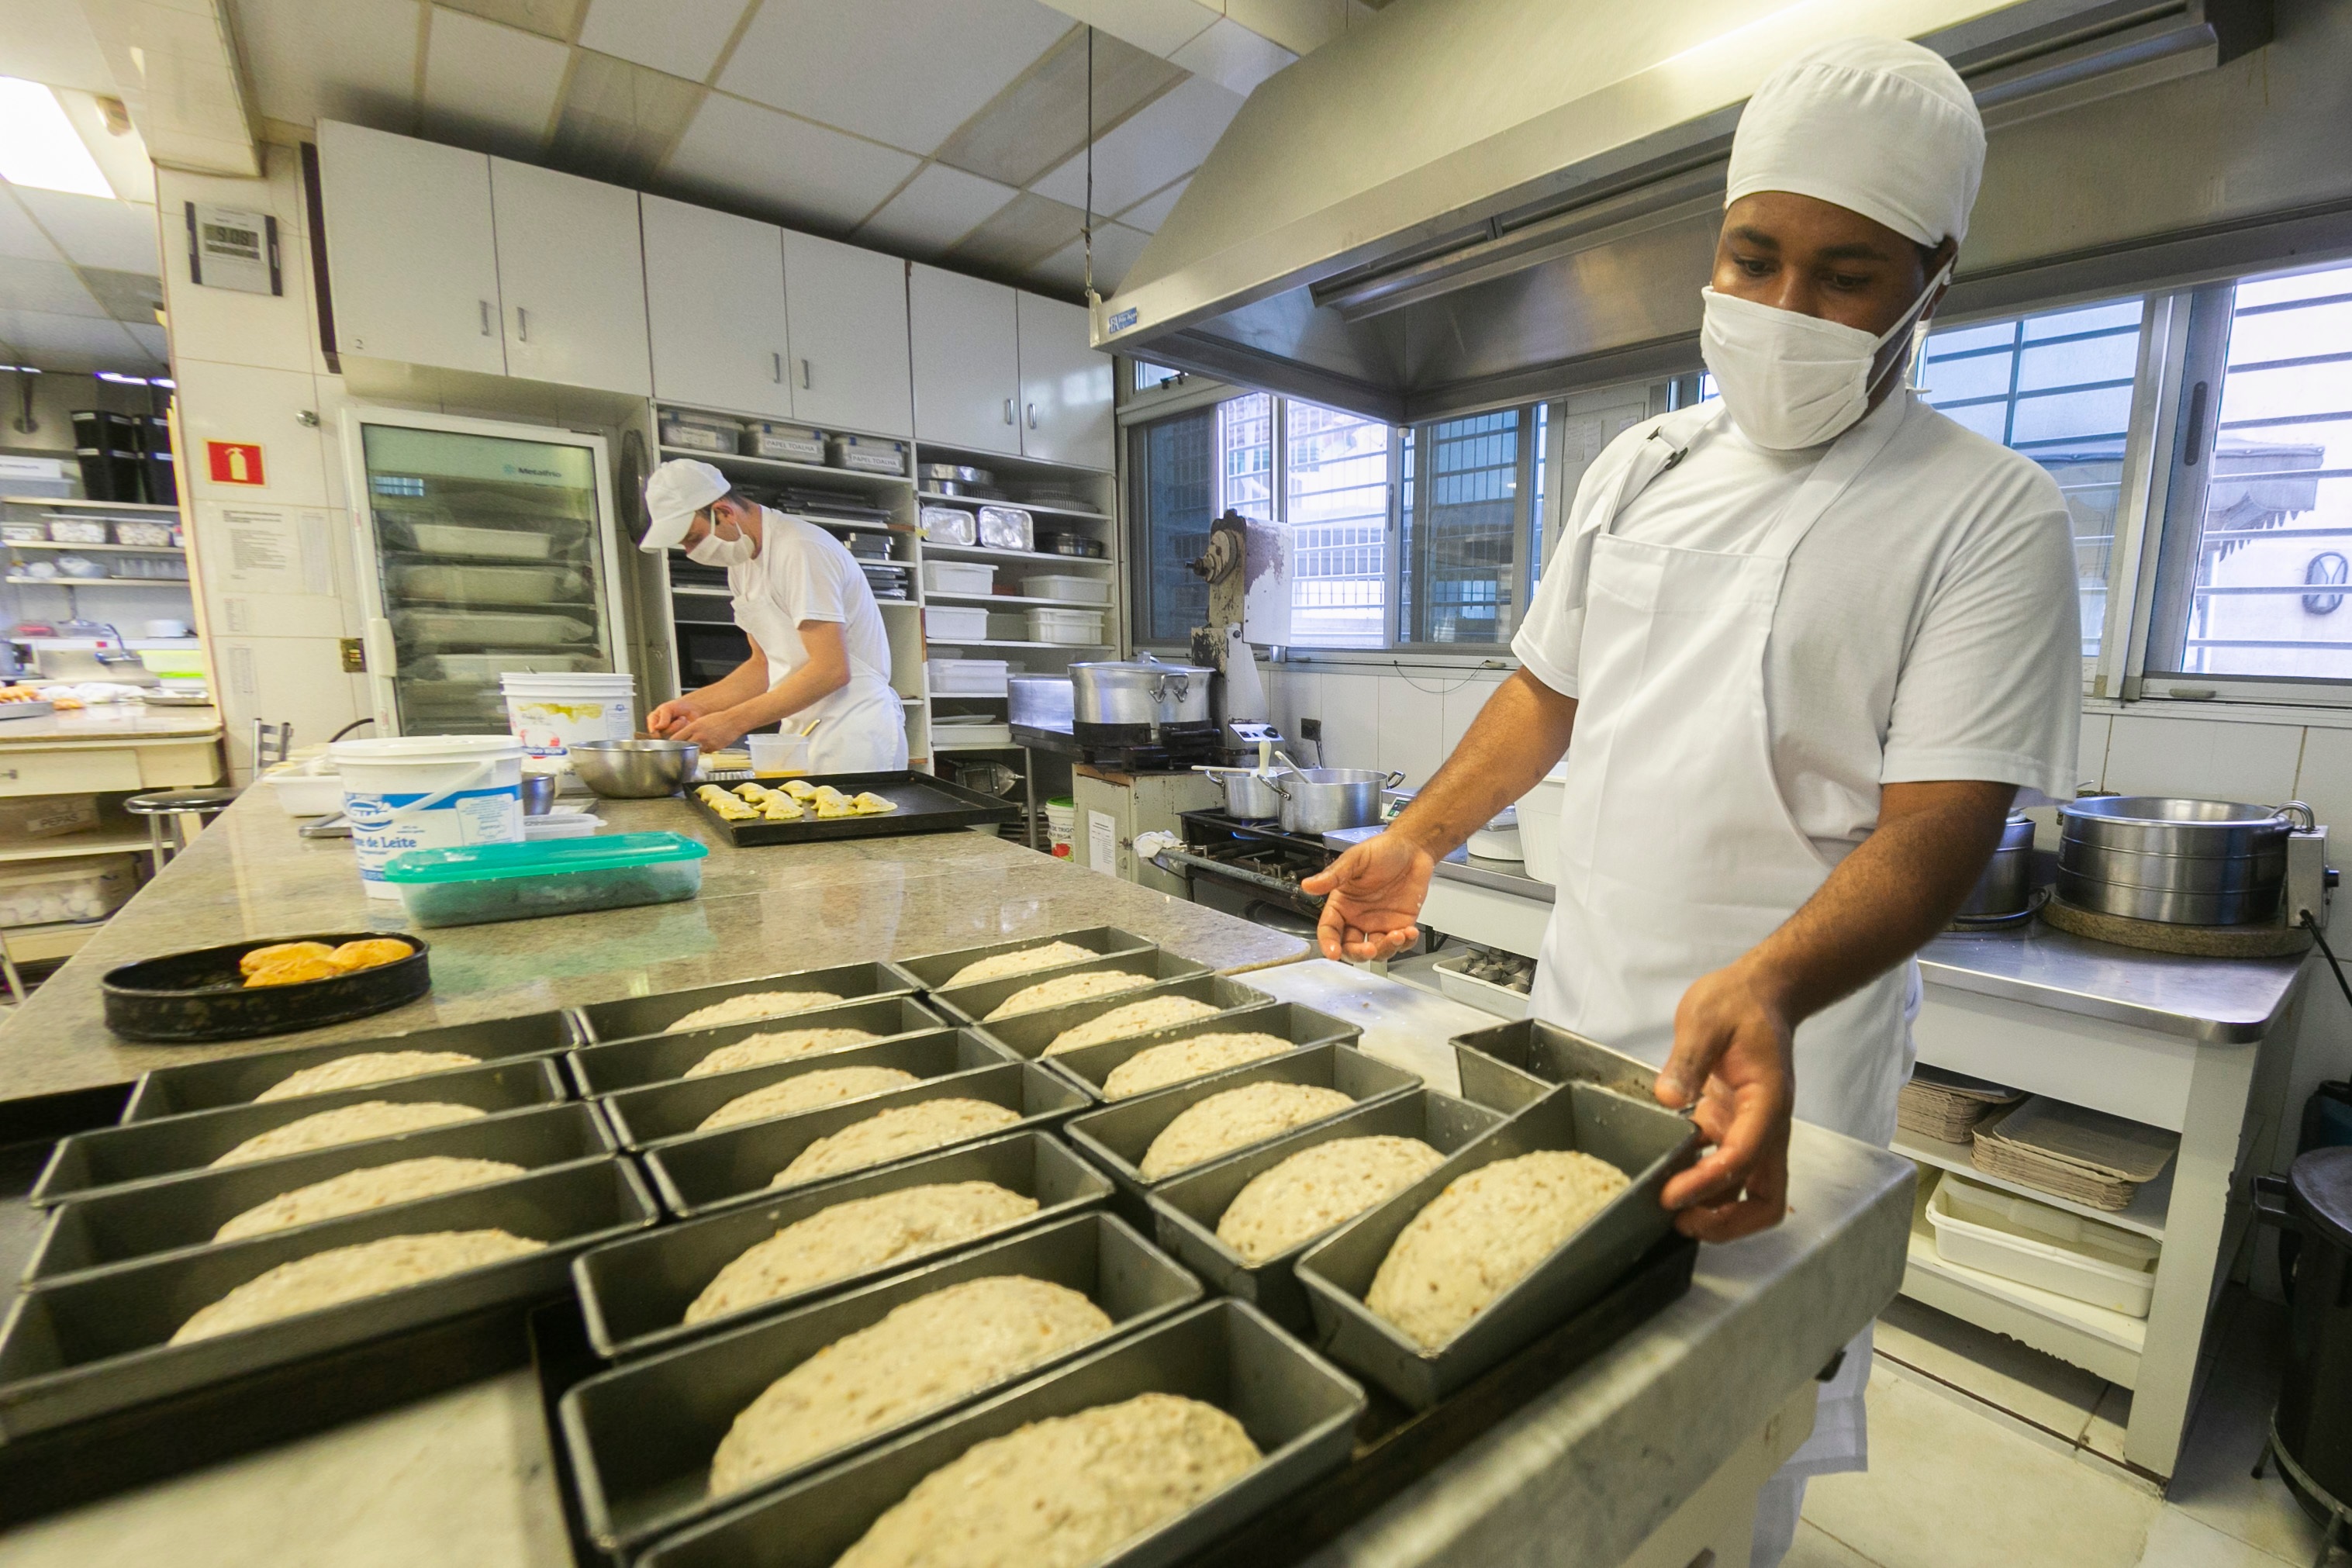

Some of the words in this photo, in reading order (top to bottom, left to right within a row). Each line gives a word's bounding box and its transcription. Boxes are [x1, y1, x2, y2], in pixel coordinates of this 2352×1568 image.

[355, 338, 364, 350] 2
[766, 440, 787, 448] PAPEL
[788, 442, 815, 451] TOALHA
[872, 458, 896, 466] TOALHA
[517, 467, 561, 478] Metalfrio
[365, 837, 378, 848] de
[380, 837, 416, 848] Leite
